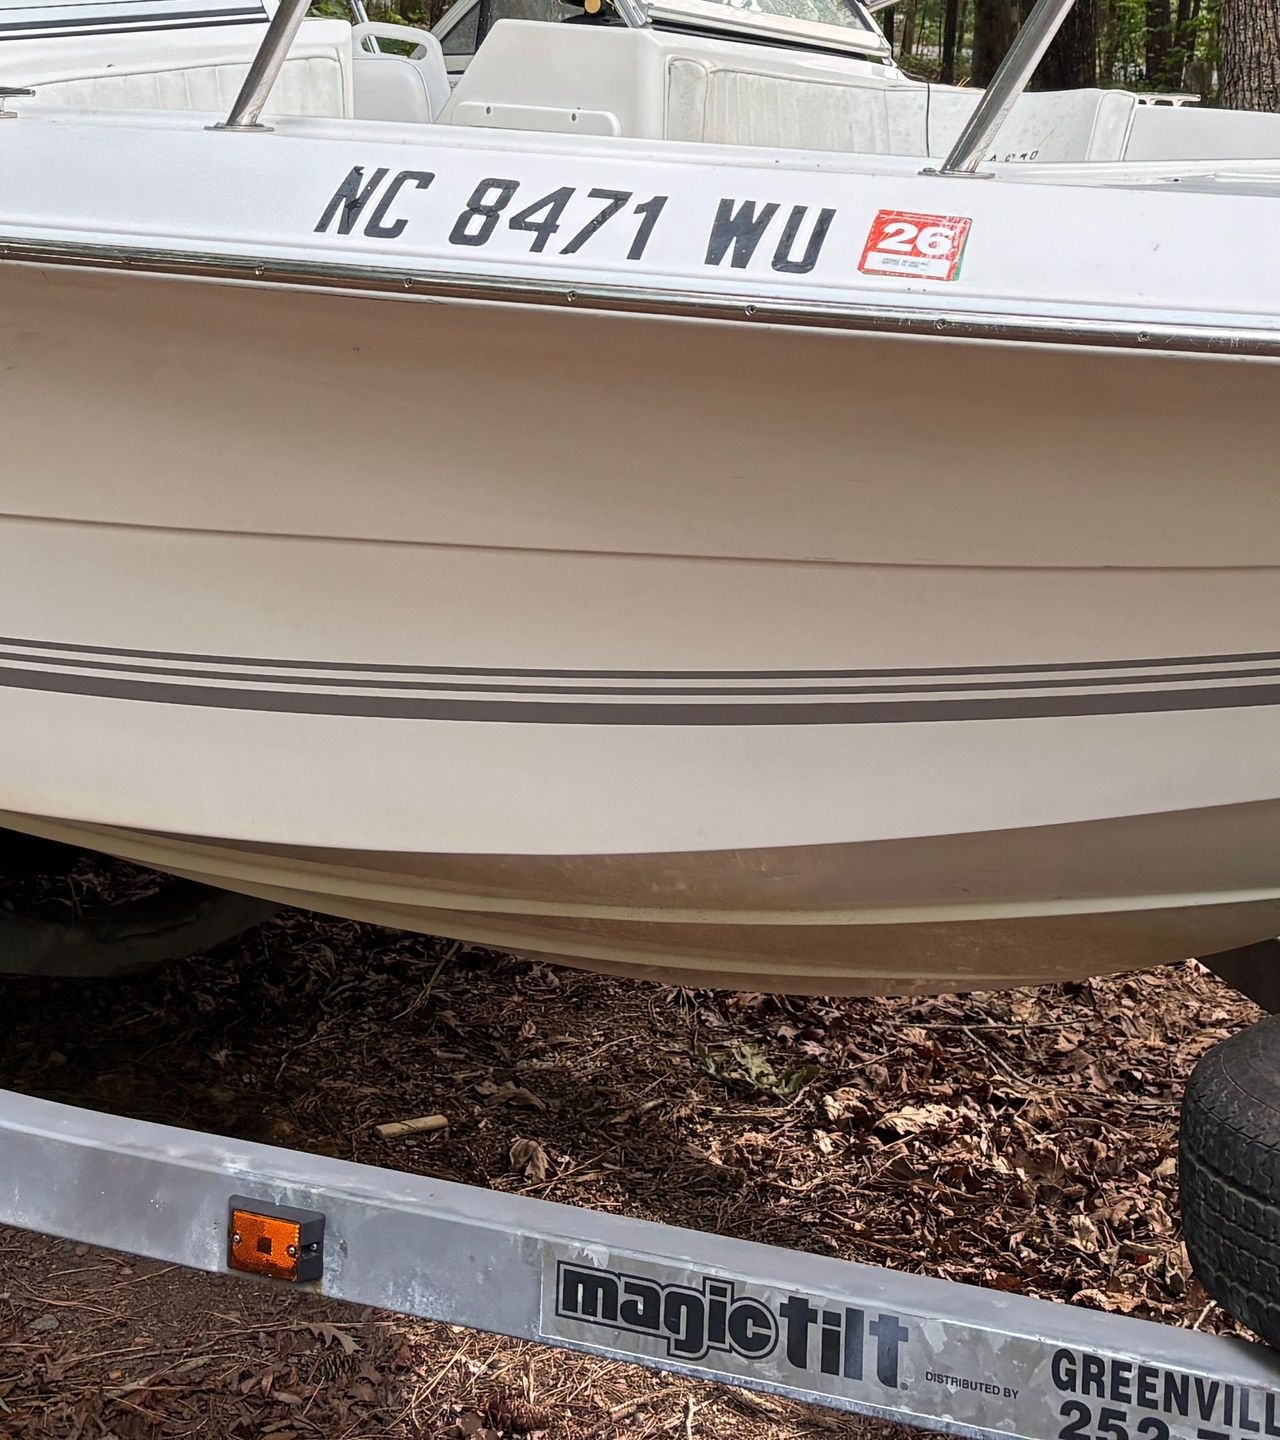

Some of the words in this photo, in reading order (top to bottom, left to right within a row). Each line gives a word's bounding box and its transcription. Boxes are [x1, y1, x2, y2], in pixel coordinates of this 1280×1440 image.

[314, 164, 435, 239] NC
[449, 177, 668, 261] 8471
[704, 198, 836, 274] WU
[877, 221, 956, 256] 26
[925, 1371, 1000, 1396] DISTRIBUTED
[1003, 1387, 1019, 1399] BY
